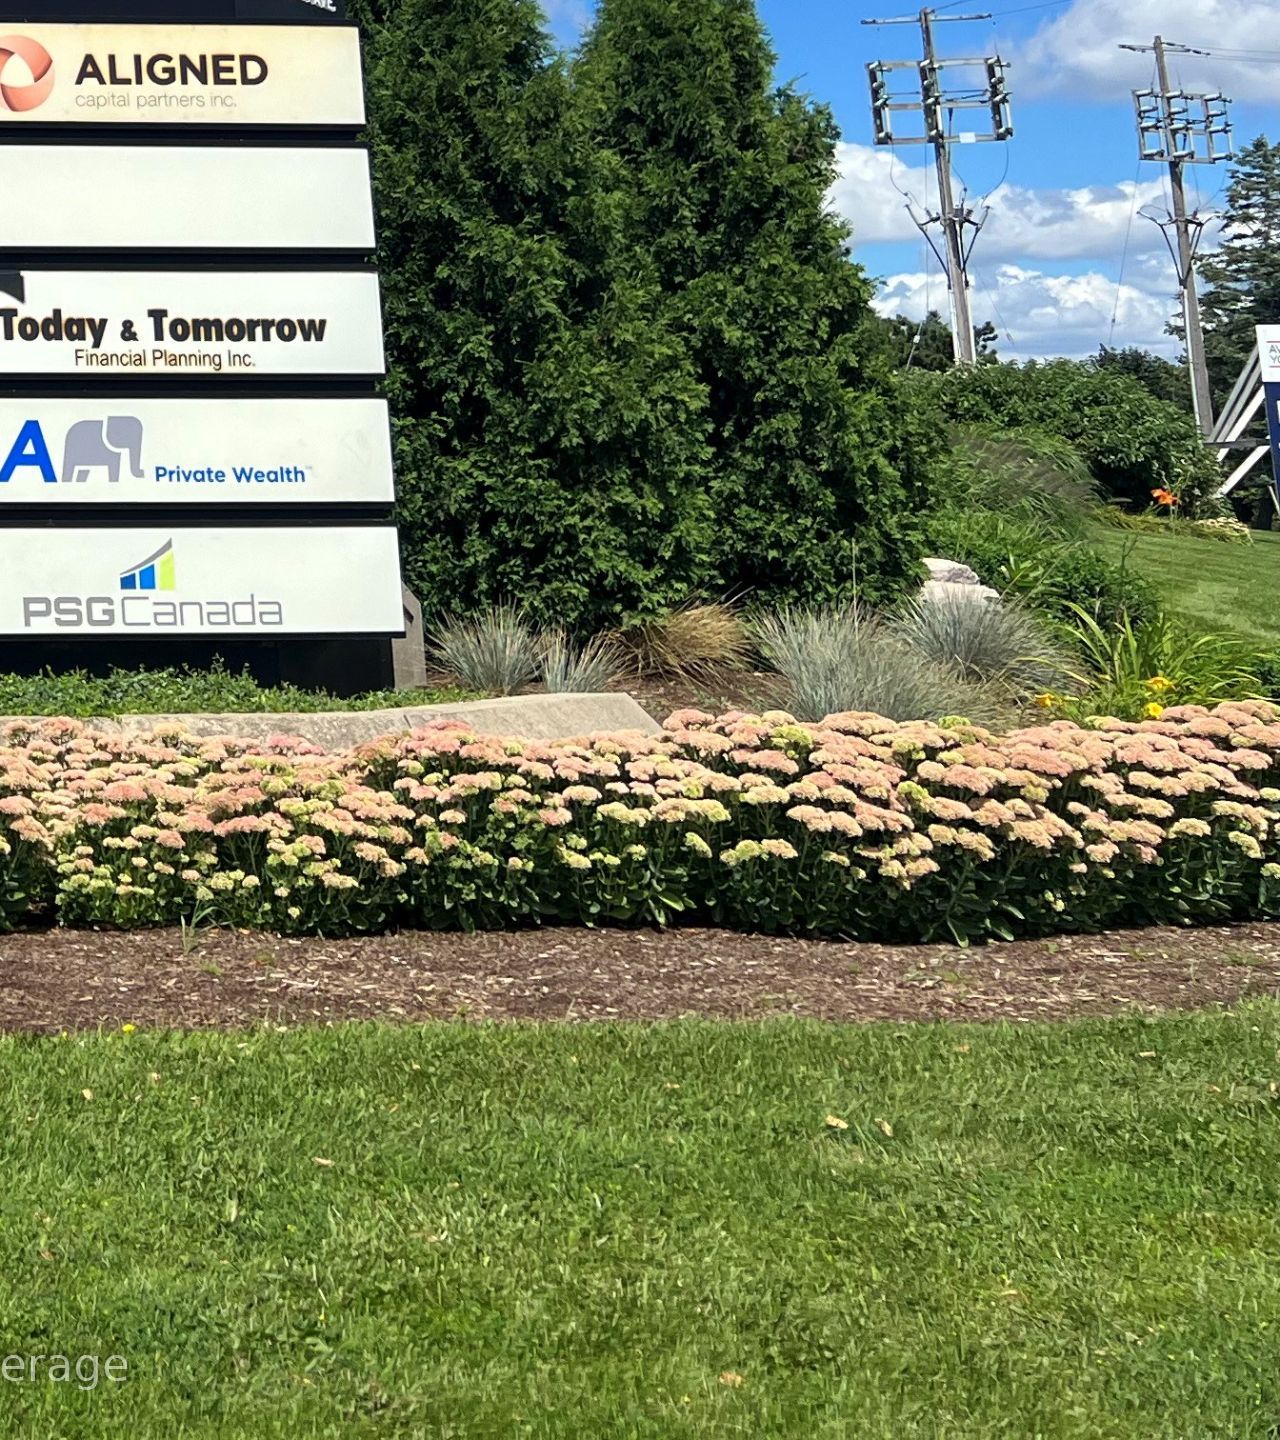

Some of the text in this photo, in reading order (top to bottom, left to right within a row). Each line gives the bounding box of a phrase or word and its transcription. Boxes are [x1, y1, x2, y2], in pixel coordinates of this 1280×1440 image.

[74, 53, 269, 86] ALIGNED
[75, 92, 238, 110] capital partners inc.
[120, 318, 139, 342] &
[147, 309, 327, 343] Tomorrow
[74, 349, 256, 370] Financial Planning Inc.
[155, 465, 306, 483] Private Wealth
